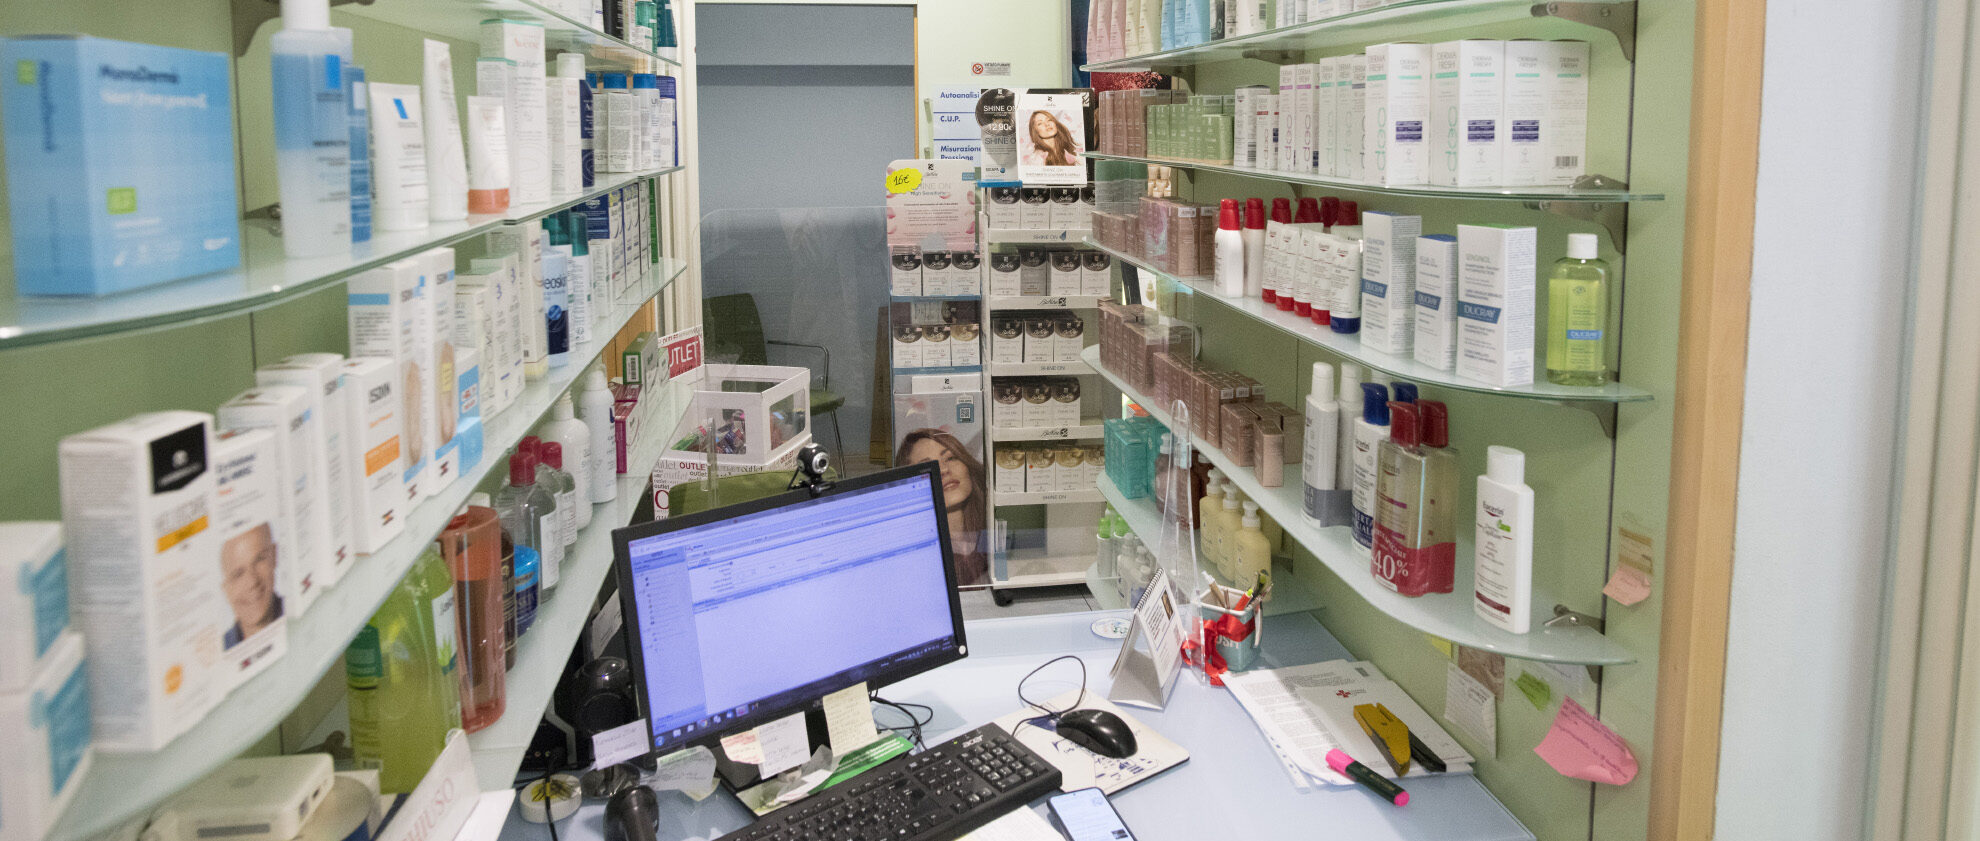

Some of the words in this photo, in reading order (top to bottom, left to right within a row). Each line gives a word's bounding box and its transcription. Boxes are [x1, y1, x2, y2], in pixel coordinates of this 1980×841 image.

[984, 137, 1009, 145] SHINE
[1010, 137, 1017, 145] O
[1463, 304, 1497, 318] DUCRAY
[679, 461, 707, 471] OUTLE
[1482, 500, 1505, 515] Eucerin
